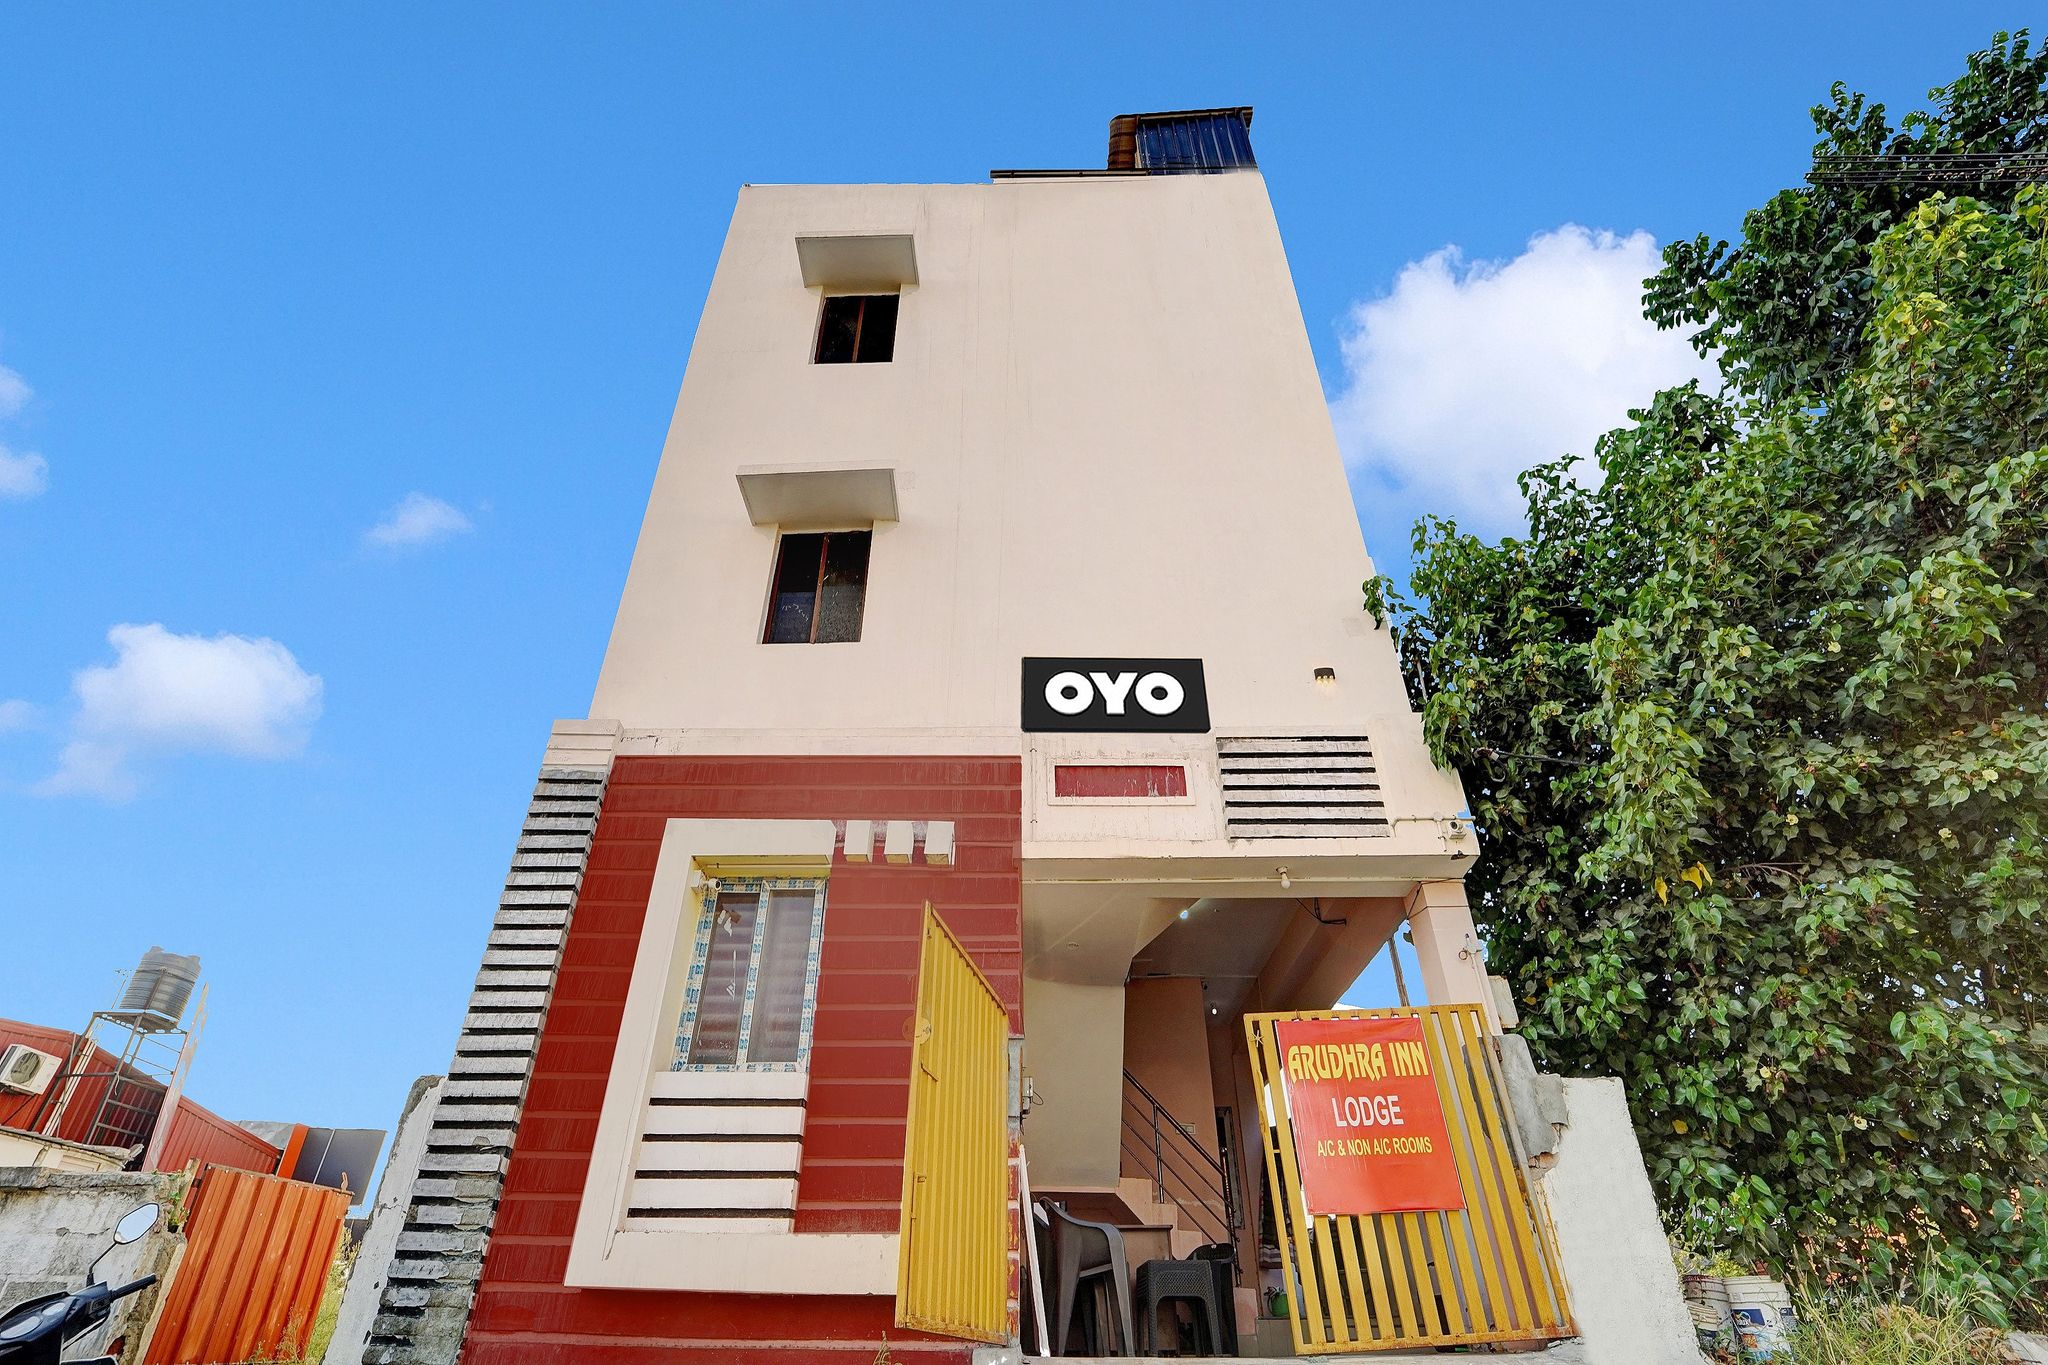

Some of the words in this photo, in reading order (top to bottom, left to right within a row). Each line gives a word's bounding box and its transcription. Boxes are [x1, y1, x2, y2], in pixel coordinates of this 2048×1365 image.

[1044, 671, 1185, 716] OYO
[1287, 1042, 1388, 1084] ARUDHRA
[1389, 1041, 1429, 1077] INN
[1331, 1095, 1404, 1127] LODGE
[1317, 1139, 1335, 1157] A/C
[1338, 1139, 1346, 1156] &
[1347, 1138, 1371, 1156] NON
[1374, 1137, 1391, 1155] A/C
[1393, 1136, 1433, 1154] ROOMS
